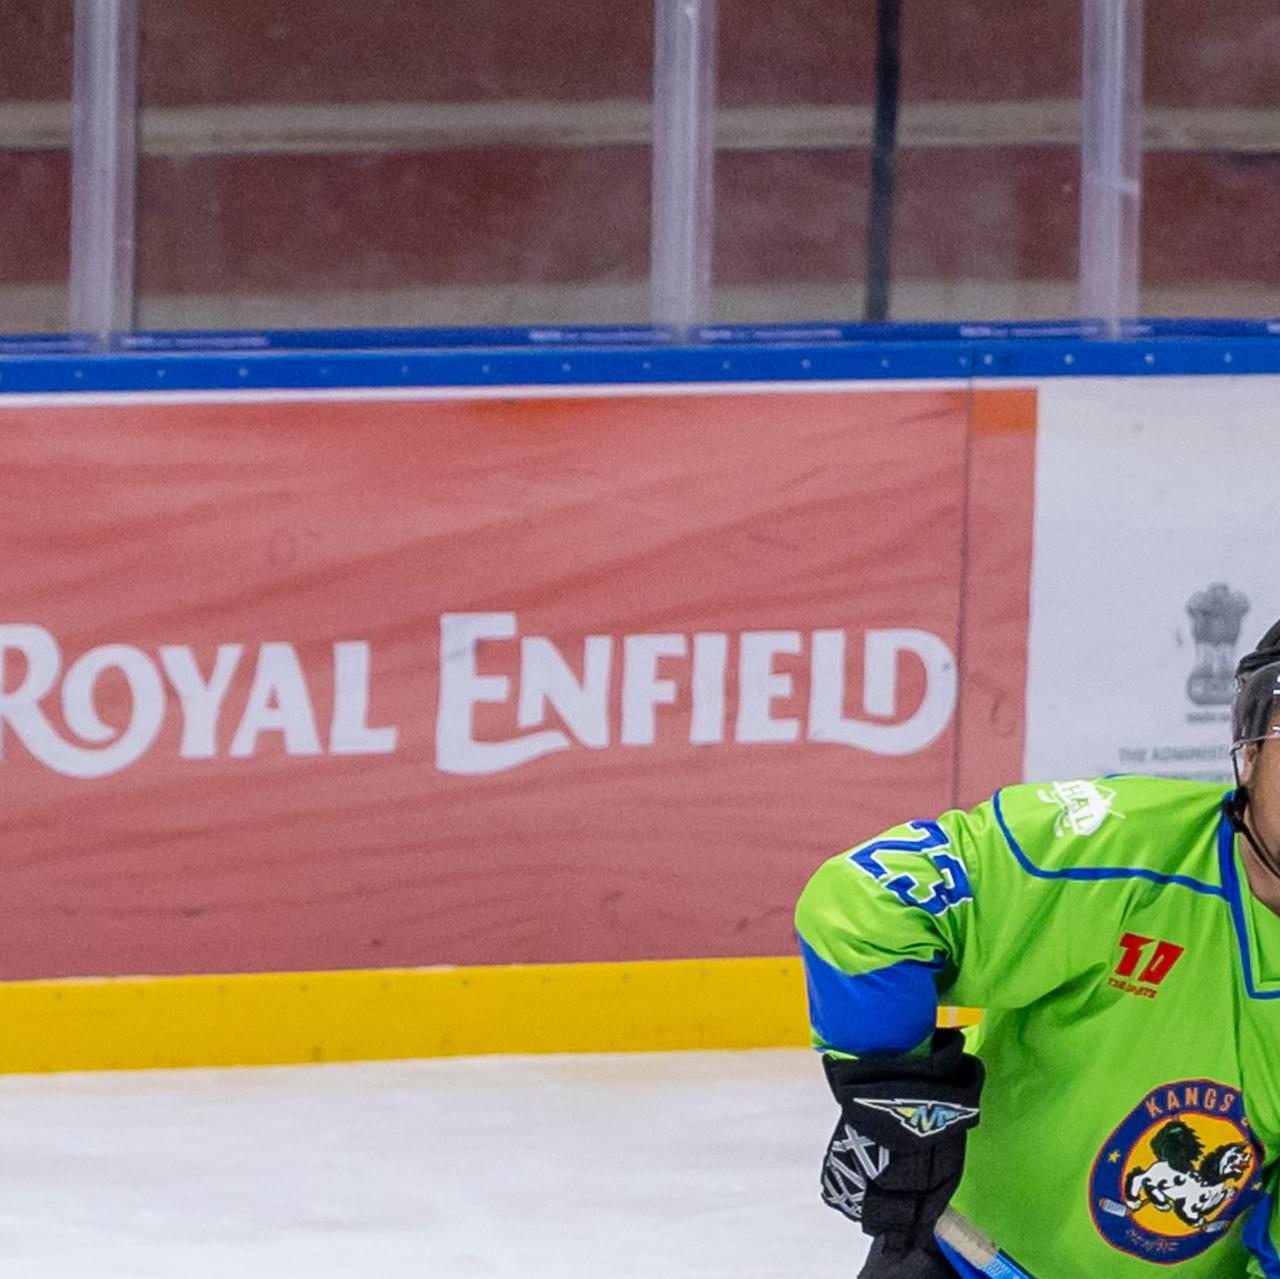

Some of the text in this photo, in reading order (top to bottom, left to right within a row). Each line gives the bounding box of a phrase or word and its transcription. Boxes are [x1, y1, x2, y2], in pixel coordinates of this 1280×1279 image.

[435, 612, 960, 774] ENFIELD
[845, 819, 975, 917] 23
[1145, 1086, 1235, 1118] KANGS
